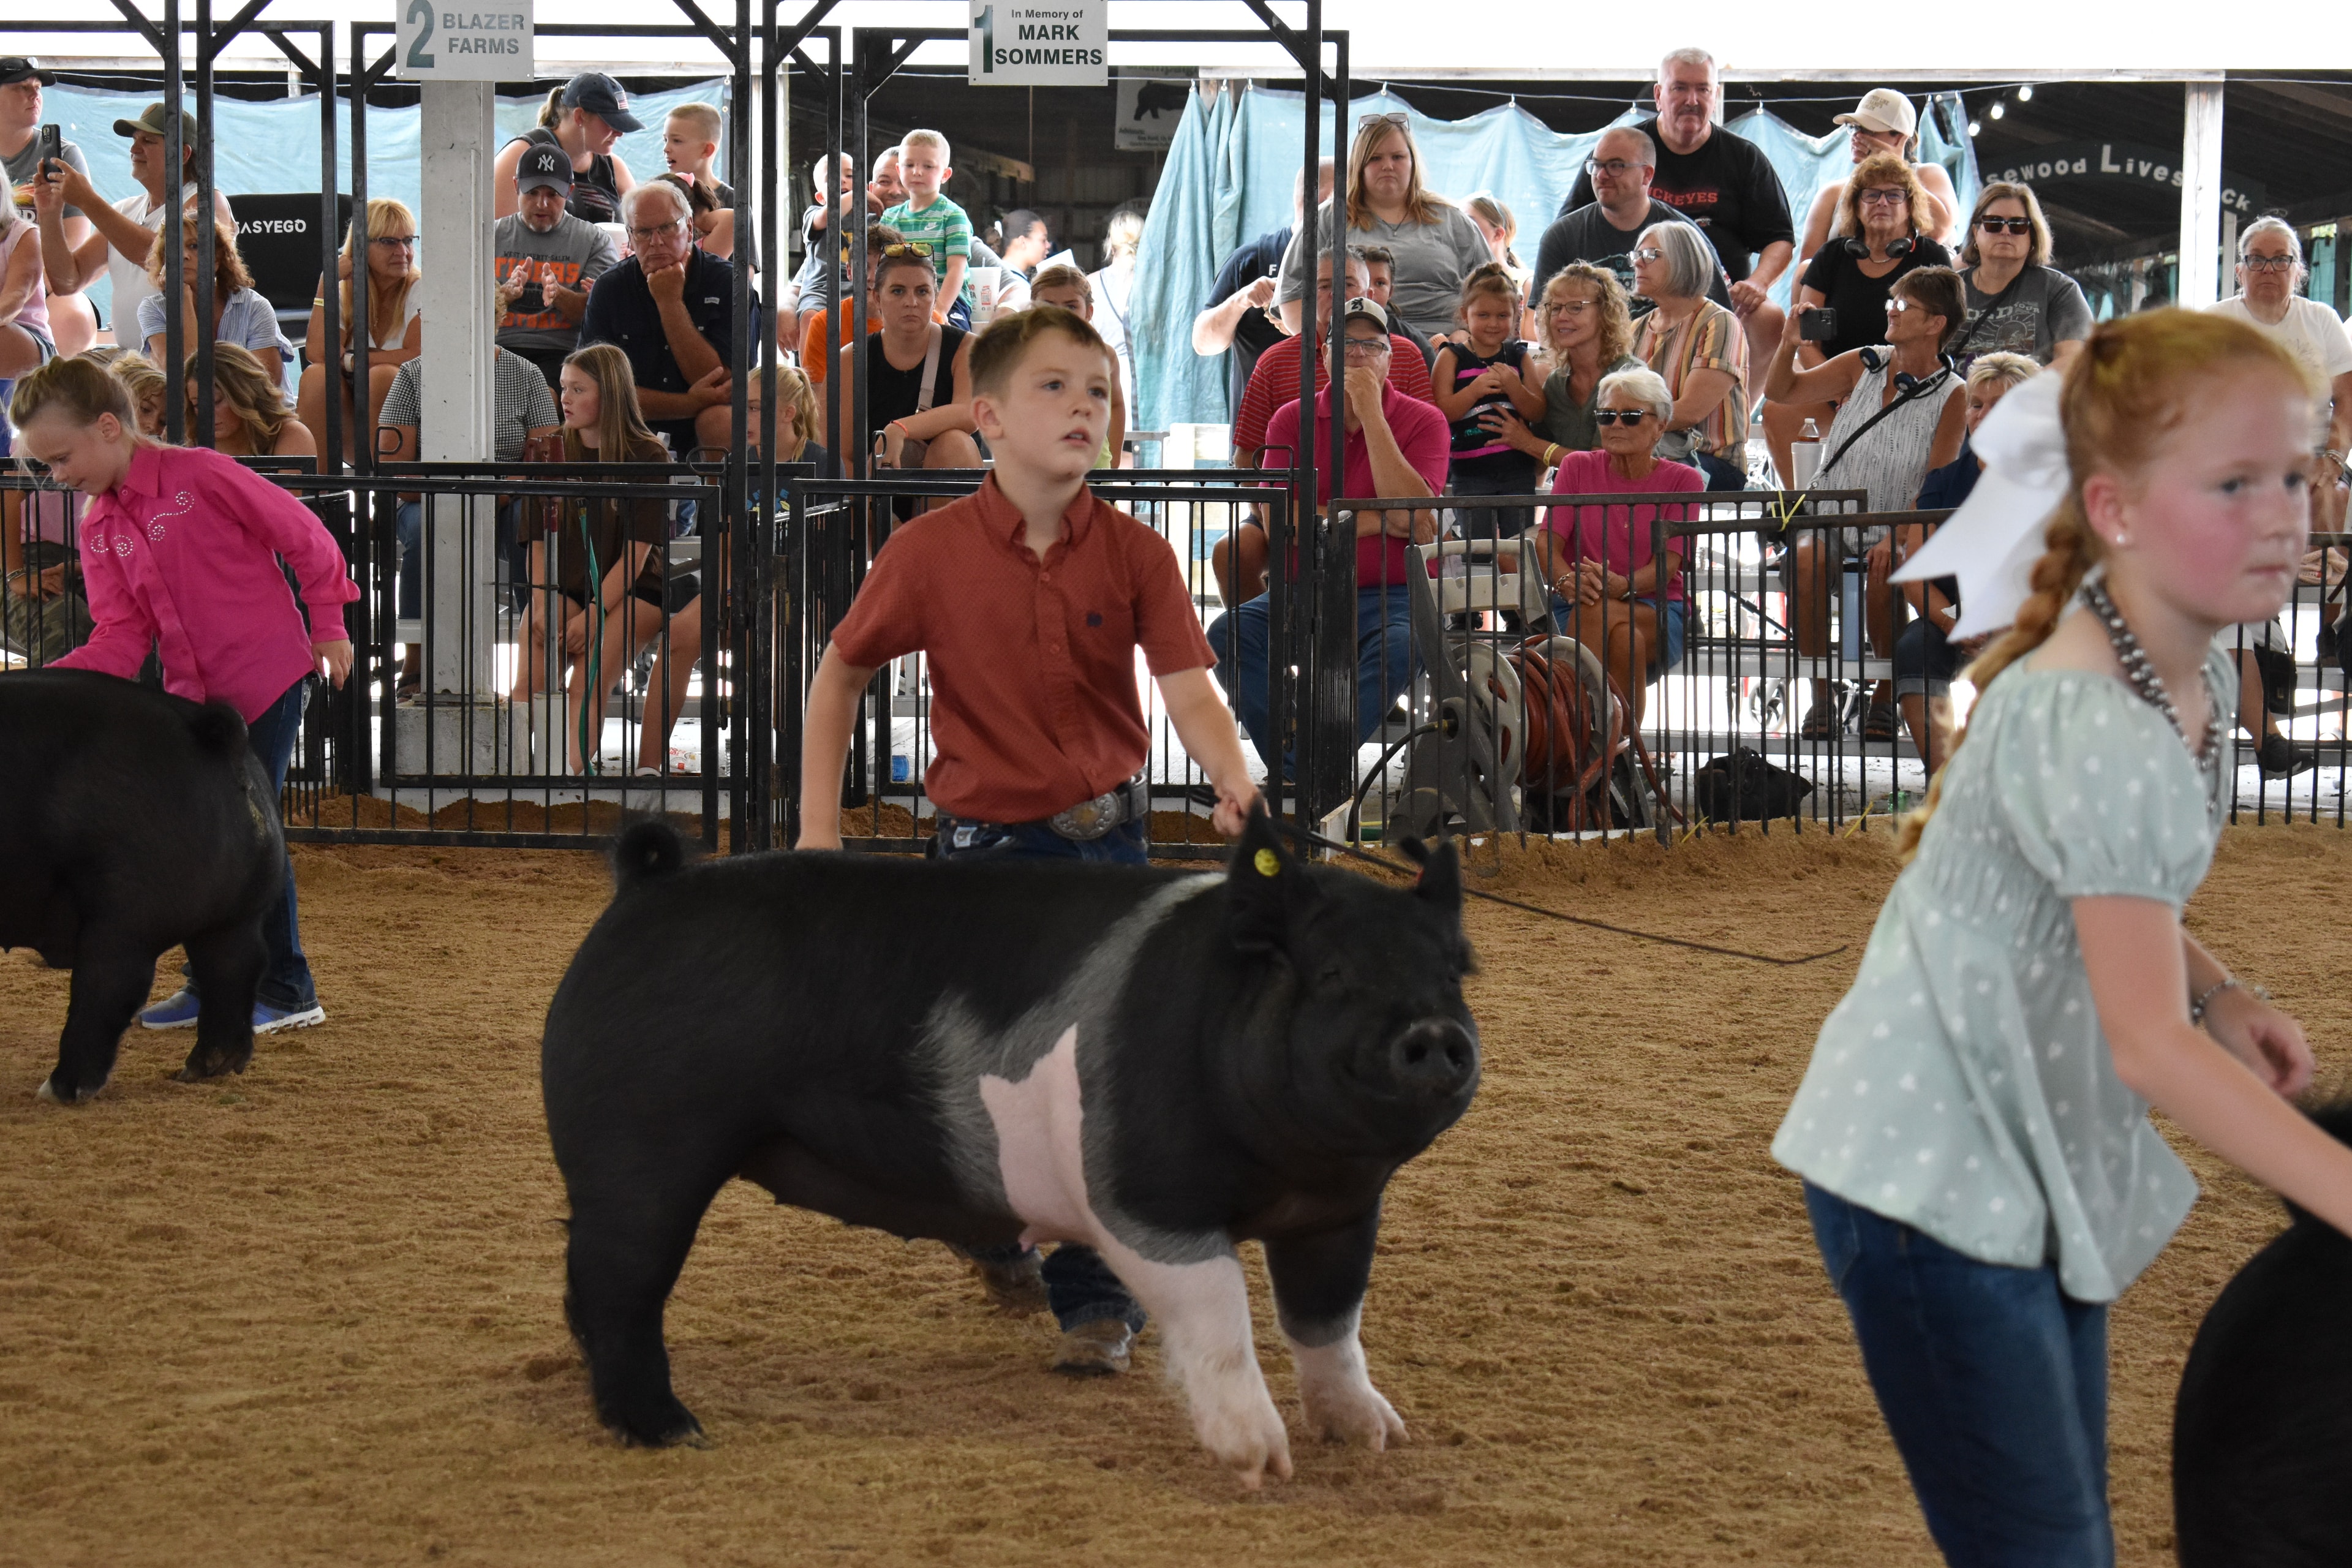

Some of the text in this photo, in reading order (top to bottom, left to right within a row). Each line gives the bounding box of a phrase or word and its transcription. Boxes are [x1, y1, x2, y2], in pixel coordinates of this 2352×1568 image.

[443, 13, 524, 30] BLAZER
[1011, 9, 1083, 20] In Memory of
[406, 0, 434, 68] 2
[974, 5, 993, 73] 1
[1019, 24, 1080, 40] MARK
[448, 37, 519, 54] FARMS
[995, 48, 1102, 65] SOMMERS
[1986, 144, 2250, 211] sewood Livesck
[1647, 186, 1718, 206] CKEYES
[235, 218, 306, 233] ASYEGO
